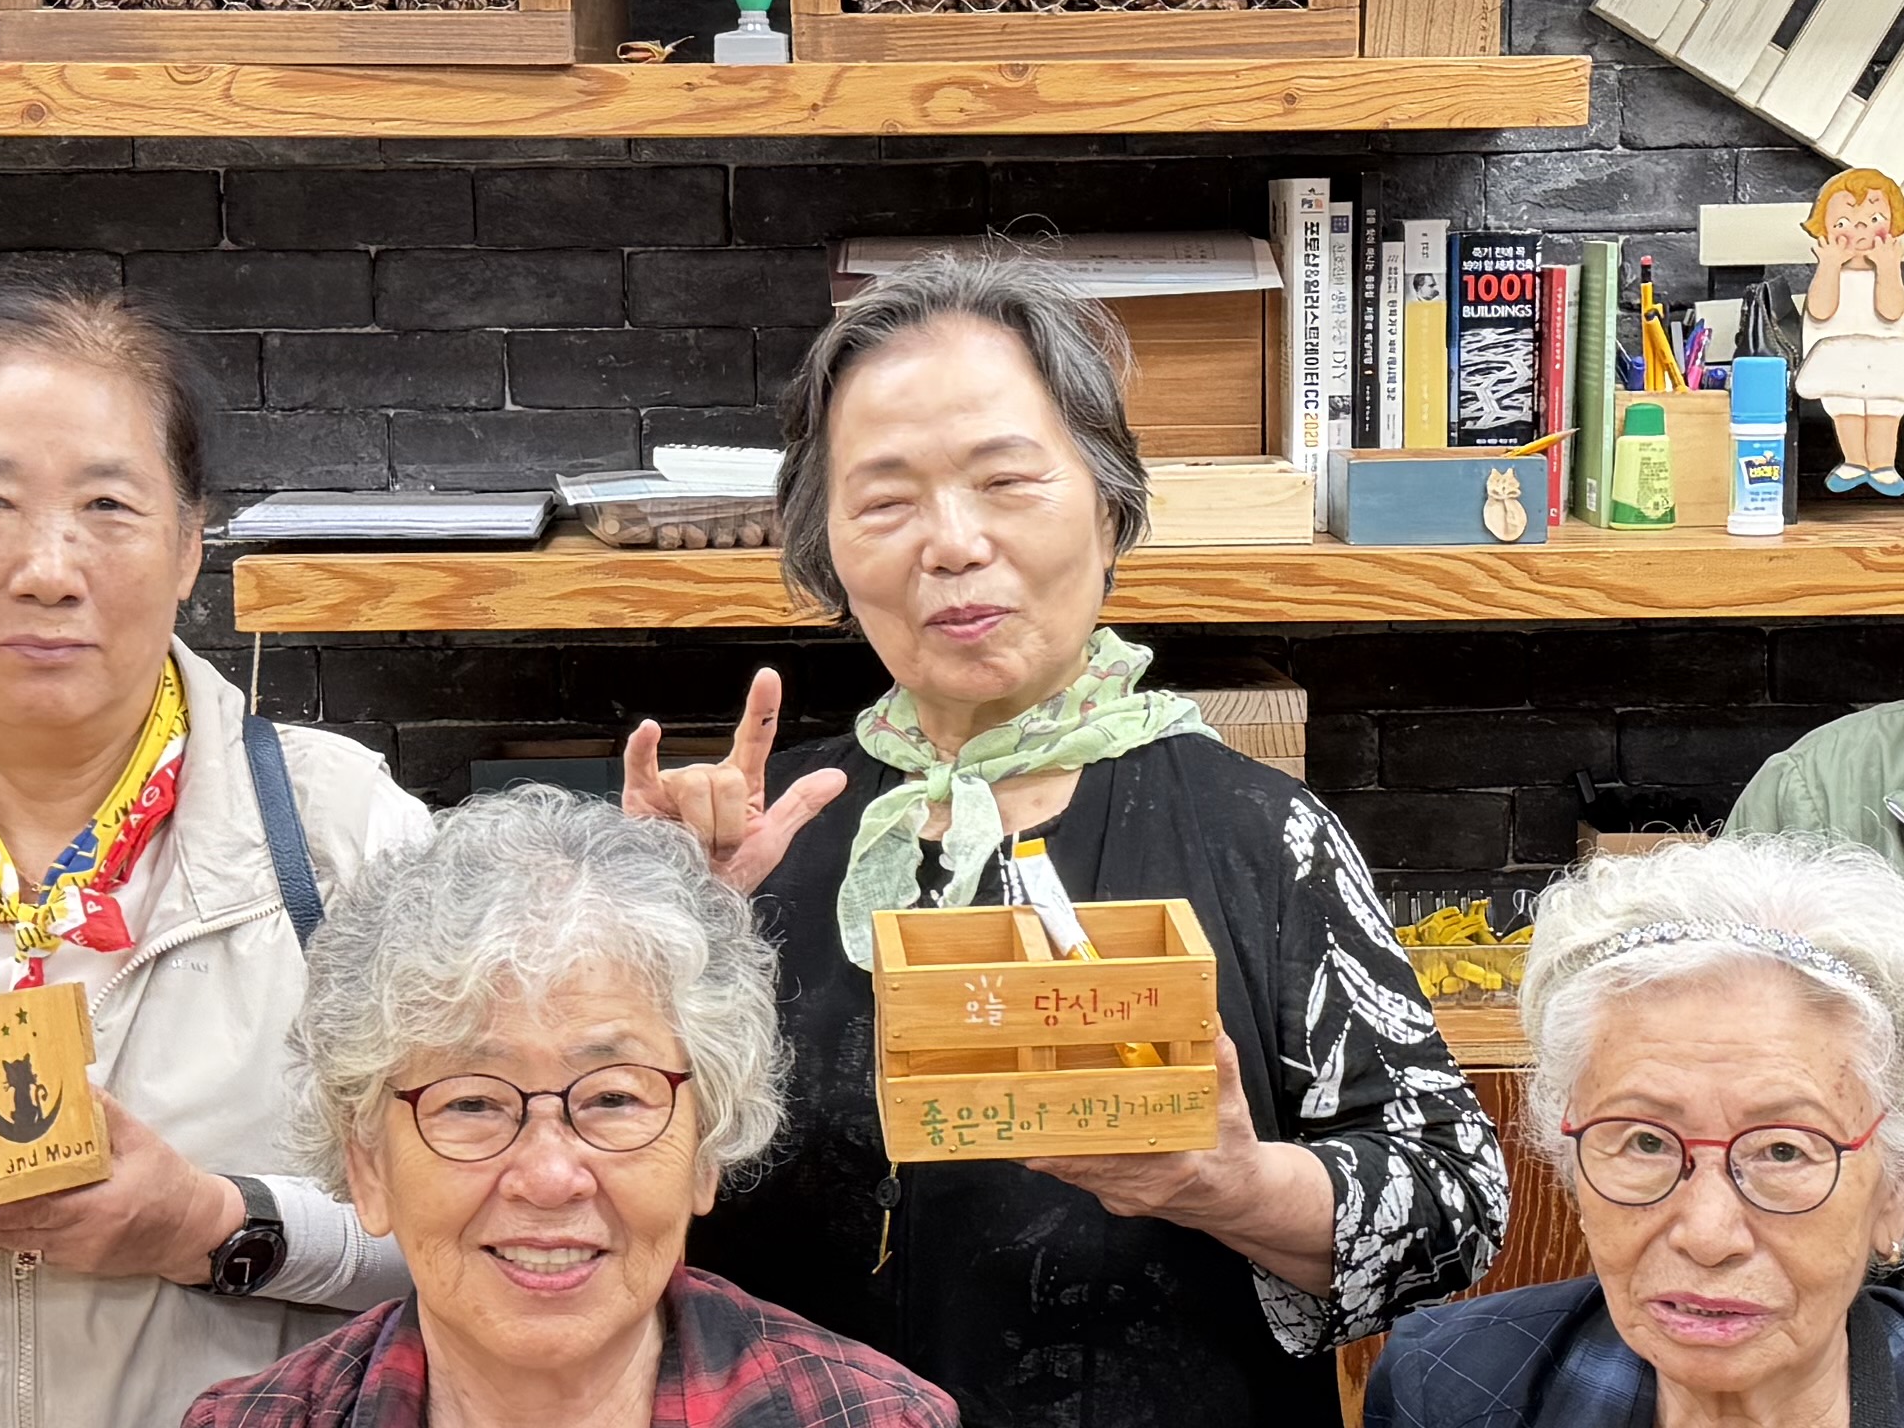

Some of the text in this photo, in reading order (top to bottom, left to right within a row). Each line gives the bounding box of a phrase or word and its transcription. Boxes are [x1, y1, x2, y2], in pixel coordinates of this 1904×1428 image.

[1462, 273, 1535, 302] 1001
[1462, 304, 1533, 319] BUILDINGS
[1303, 389, 1320, 410] CC
[1303, 412, 1320, 449] 2020
[964, 988, 1160, 1028] 오늘 당신에게
[5, 1148, 39, 1174] and
[45, 1139, 95, 1162] Moon
